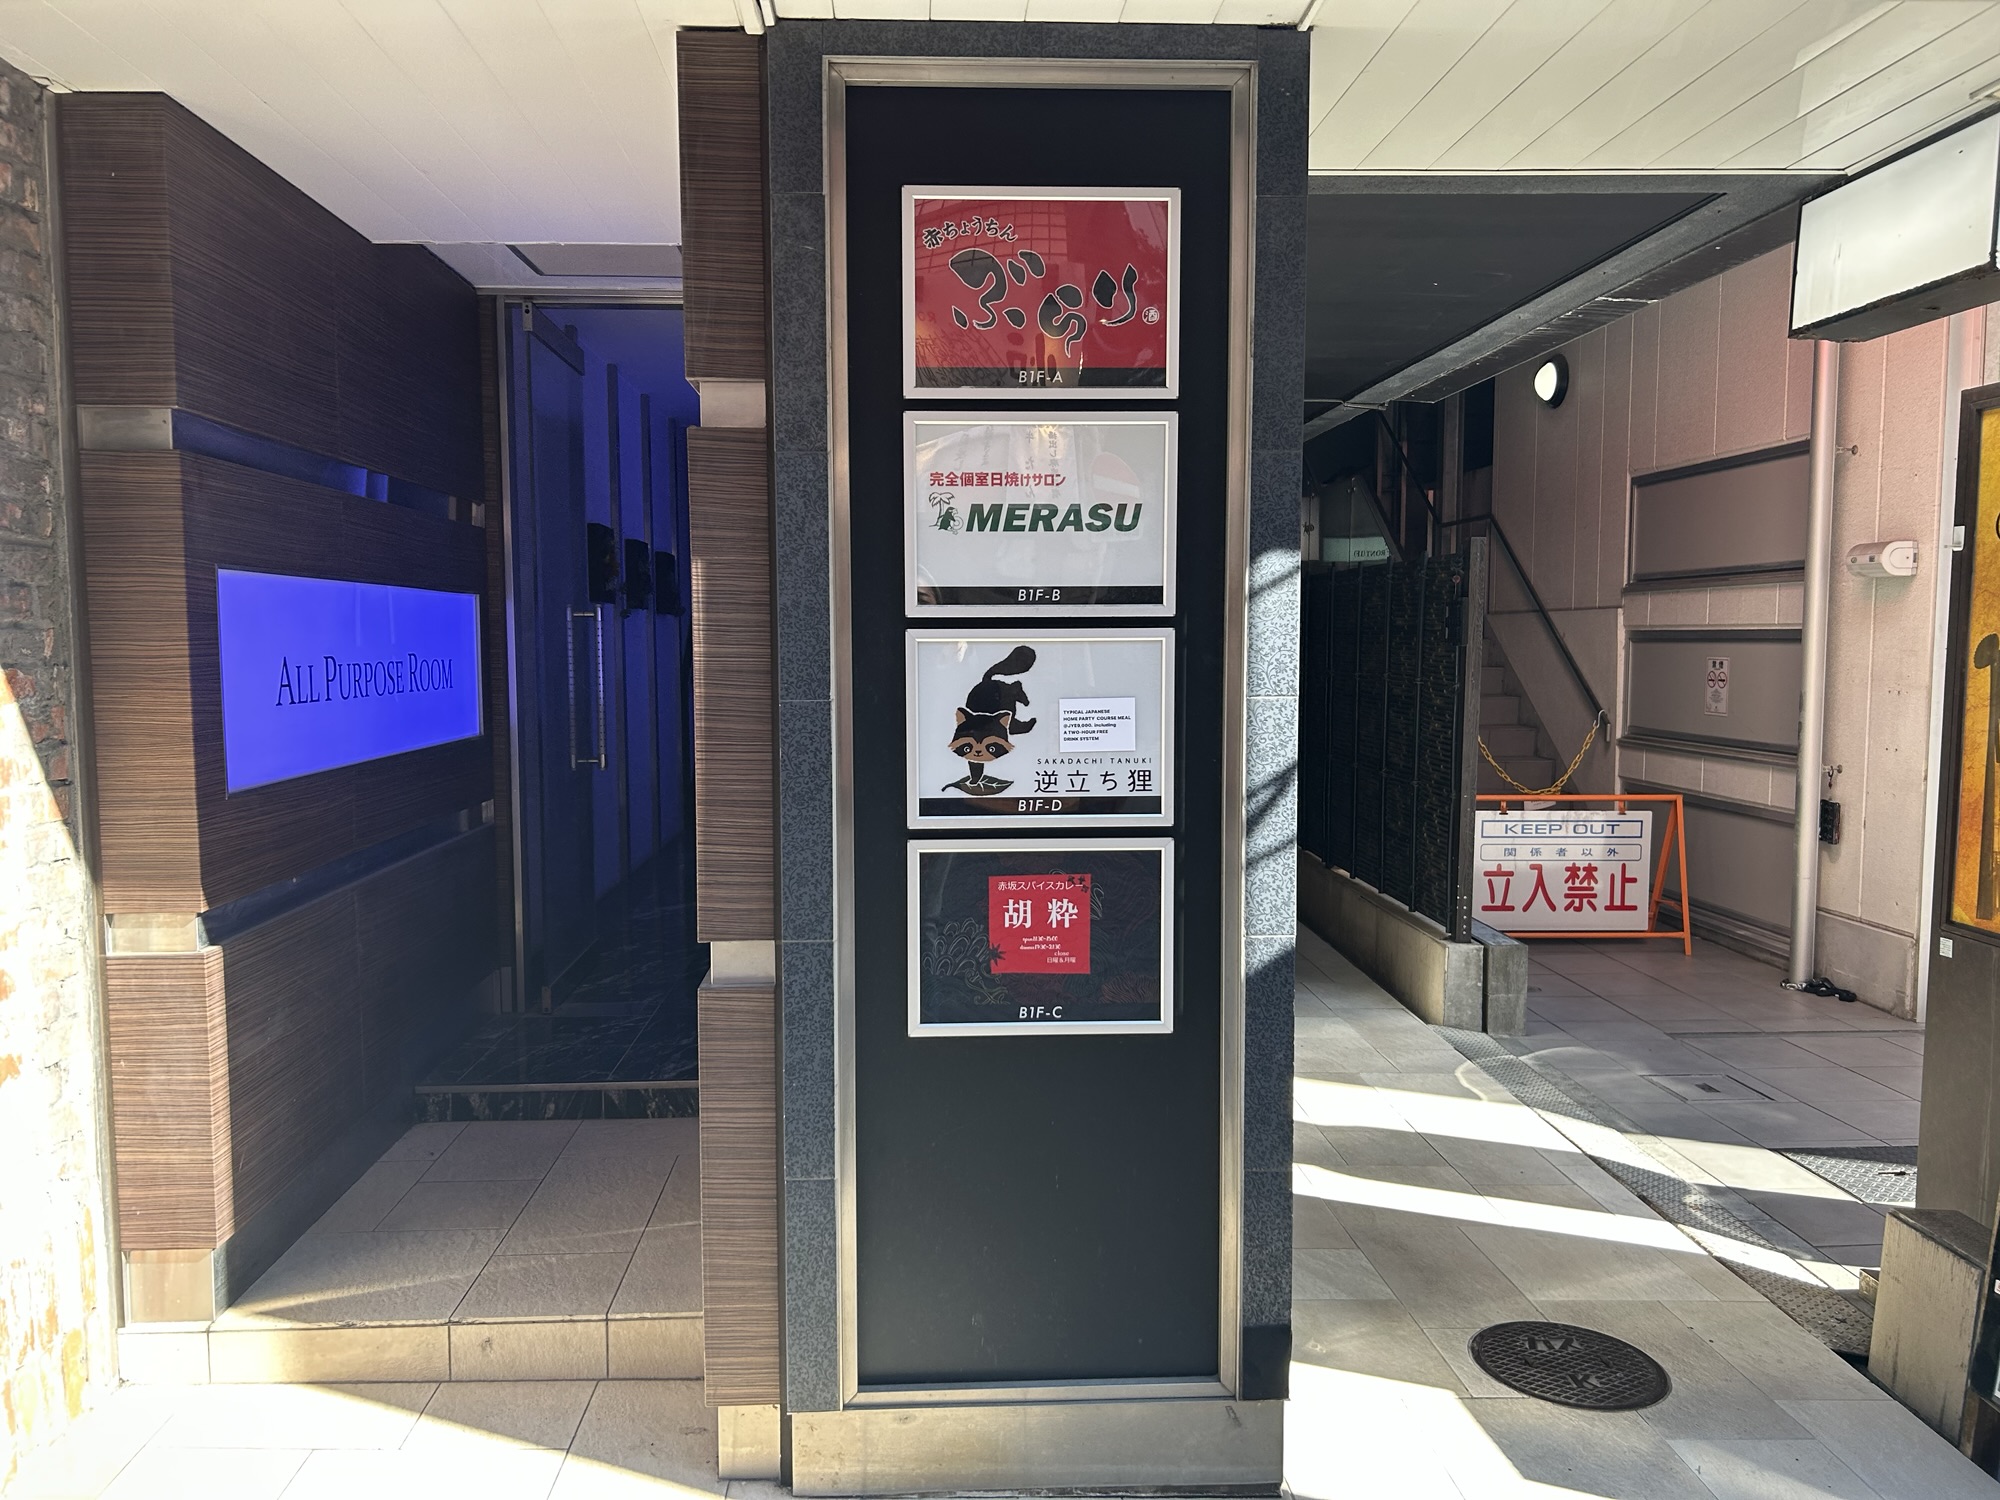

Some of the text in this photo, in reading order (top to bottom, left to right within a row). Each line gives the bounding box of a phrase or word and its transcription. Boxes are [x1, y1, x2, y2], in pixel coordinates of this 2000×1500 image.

[922, 215, 1018, 249] 赤ちょうちん
[1018, 371, 1063, 384] B1F-A
[929, 472, 1067, 488] 完全個室日焼けサロン
[965, 503, 1143, 532] MERASU
[1017, 588, 1061, 601] B1F-B
[1034, 769, 1153, 793] 逆立ち狸
[1018, 799, 1062, 812] B1F-D
[1504, 823, 1620, 834] KEEP OUT
[1503, 847, 1619, 857] 関係者以外
[1481, 863, 1638, 912] 立入禁止
[1003, 899, 1079, 929] 胡粋
[1019, 1006, 1063, 1019] B1F-C
